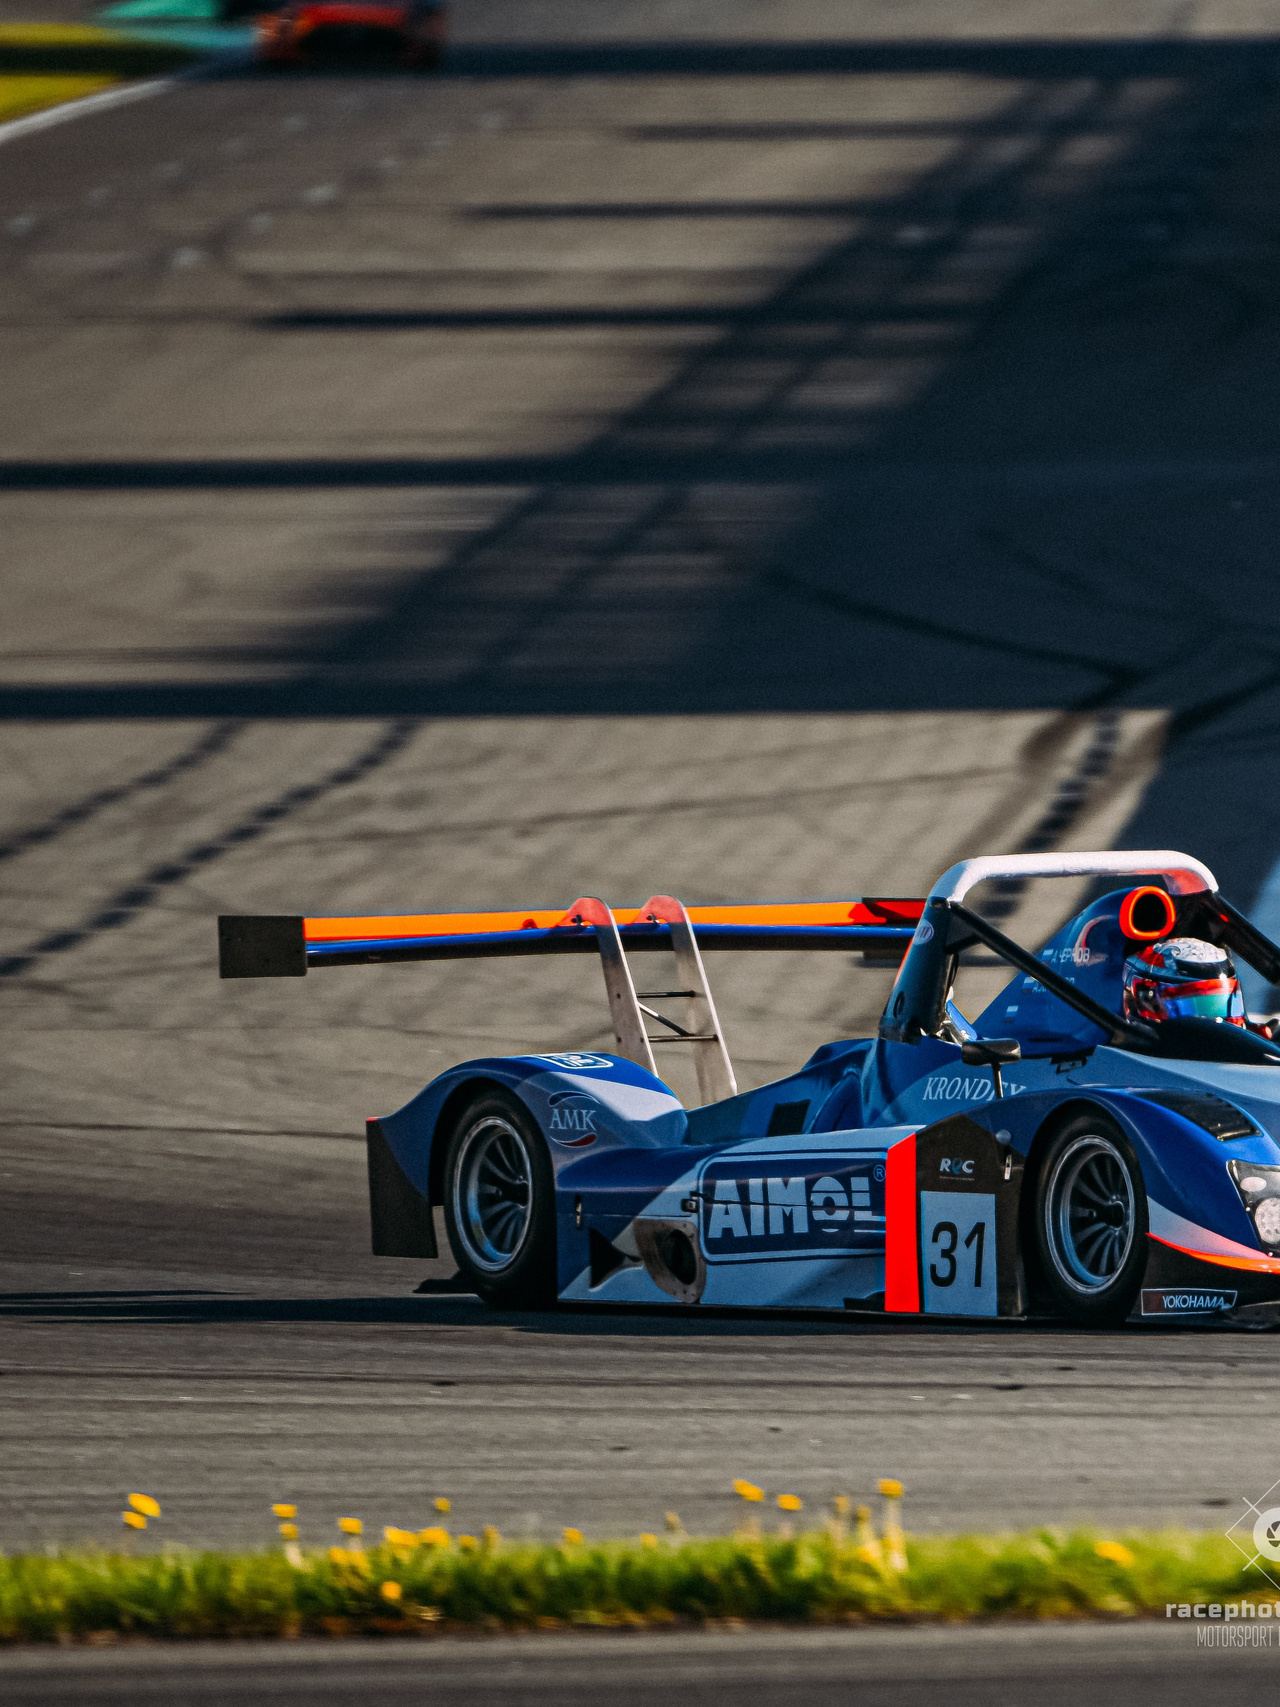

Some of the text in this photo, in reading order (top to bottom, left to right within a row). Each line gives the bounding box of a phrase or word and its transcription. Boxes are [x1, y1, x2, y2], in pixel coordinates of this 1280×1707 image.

[549, 1108, 597, 1131] AMK
[707, 1176, 887, 1239] AIMOL
[929, 1220, 987, 1288] 31
[1162, 1294, 1226, 1309] YOKOHAMA
